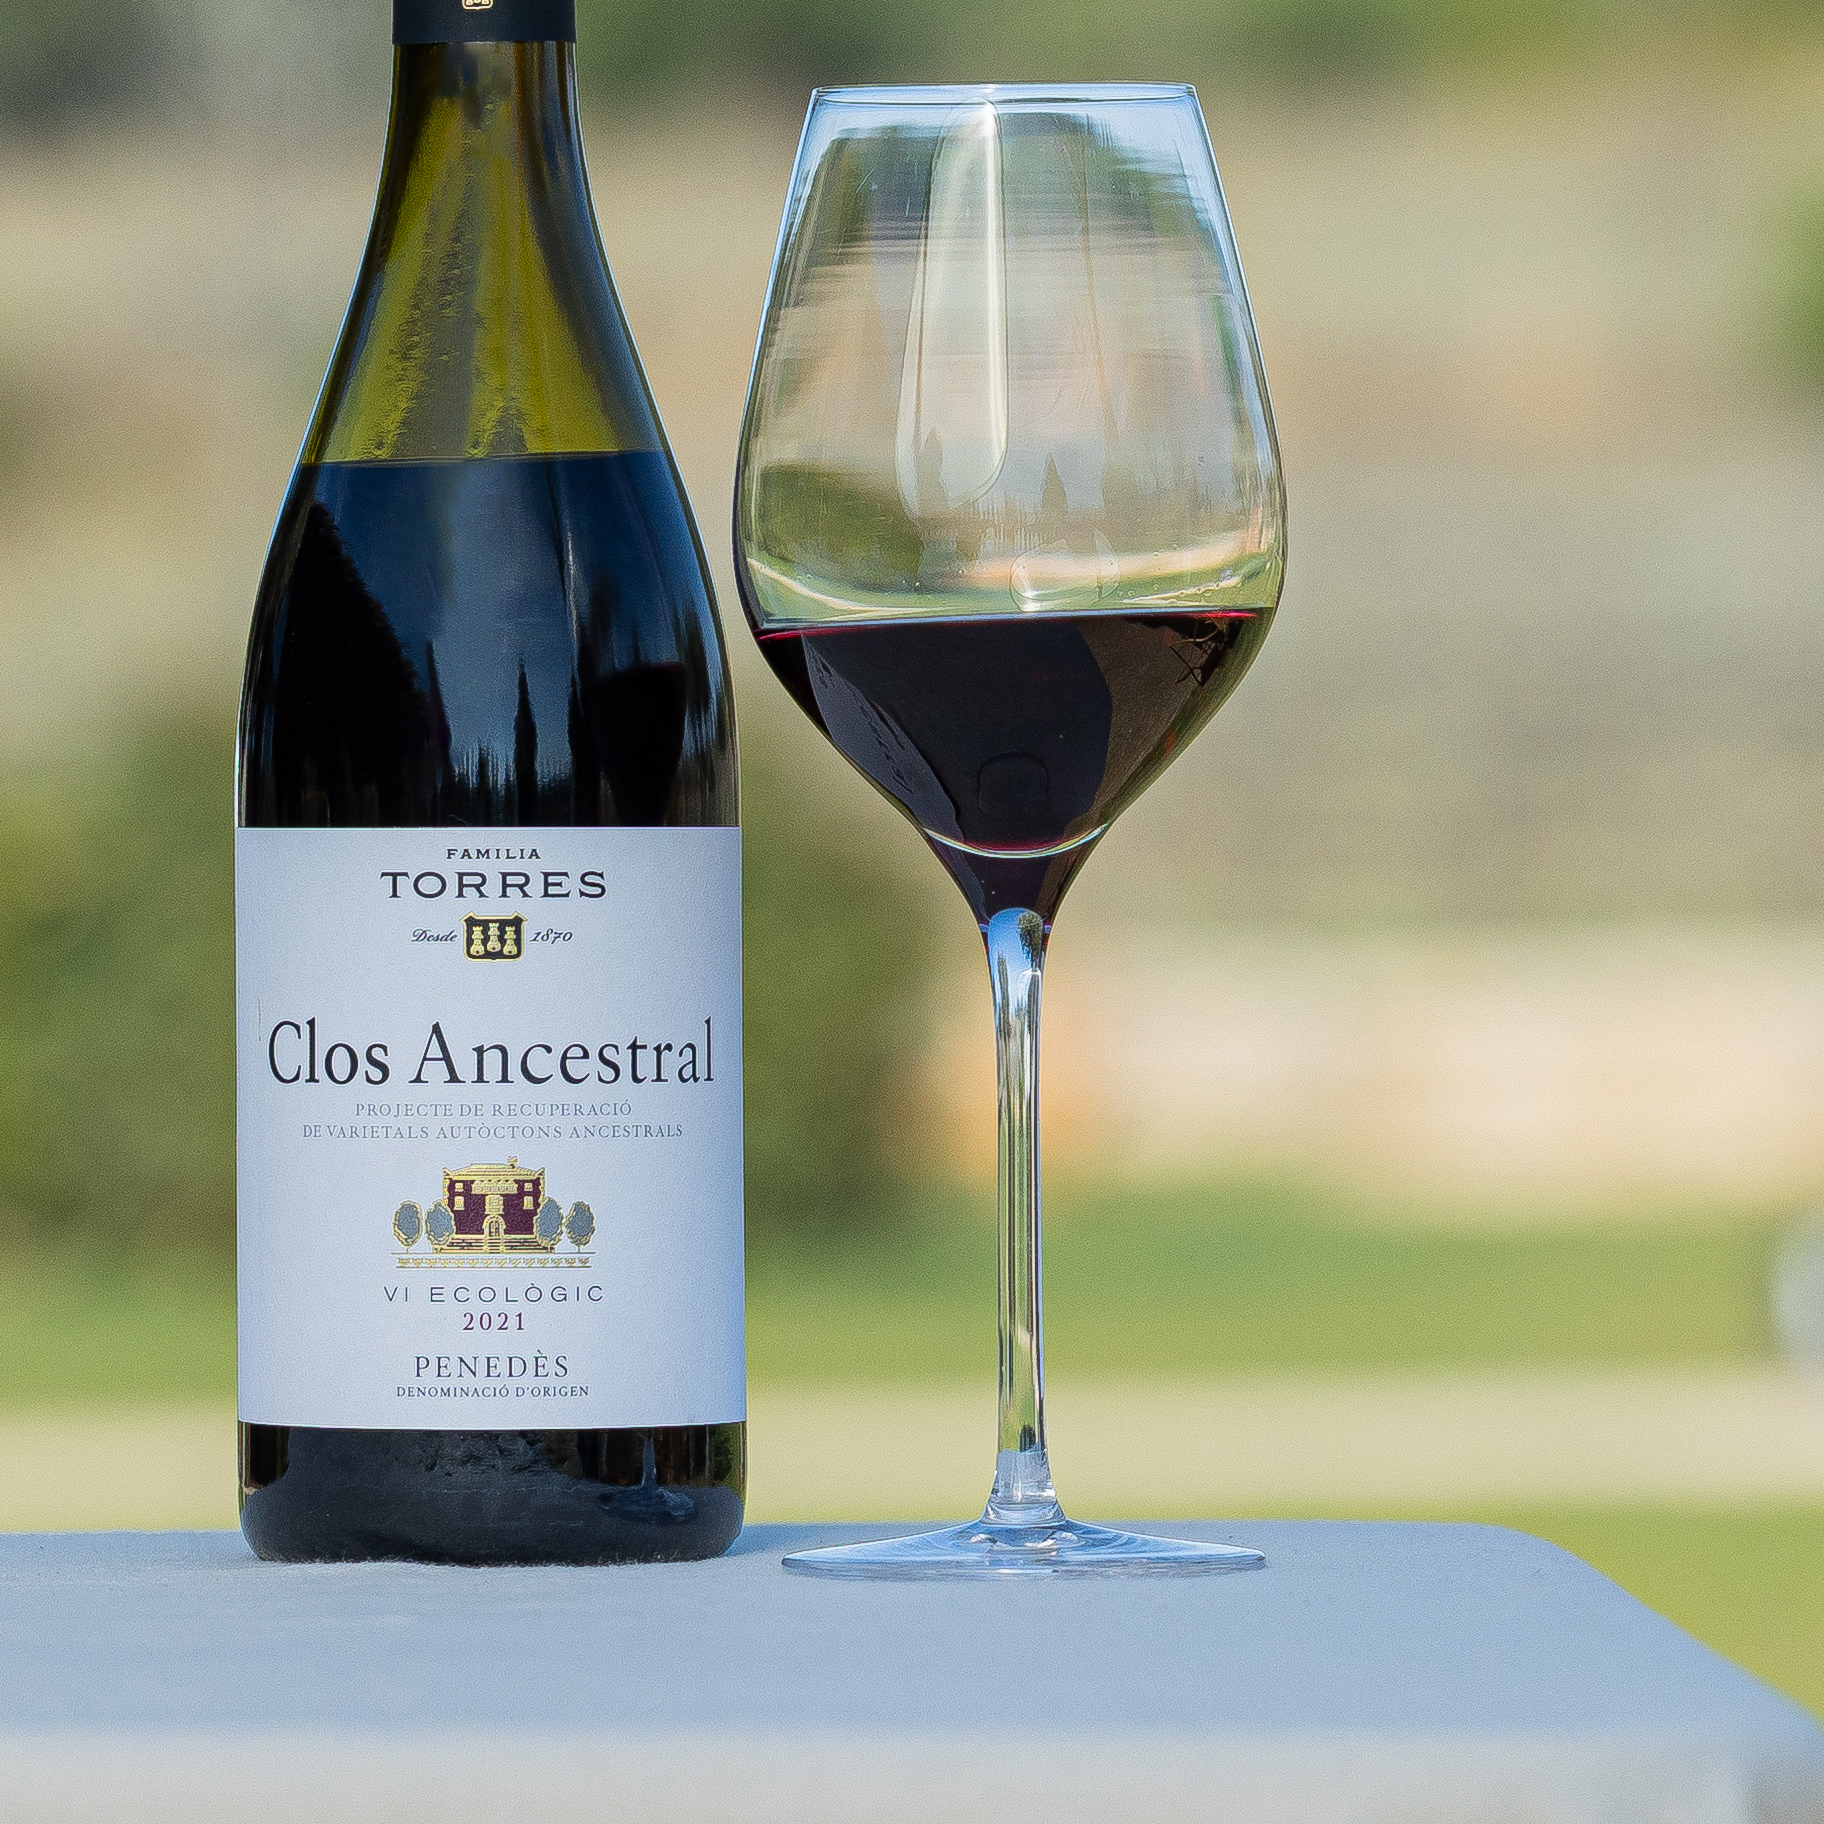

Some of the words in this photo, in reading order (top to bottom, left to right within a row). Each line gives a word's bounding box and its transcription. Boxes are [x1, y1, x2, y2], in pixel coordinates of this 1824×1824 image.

[445, 848, 542, 860] FAMILIA
[379, 870, 607, 899] TORRES
[410, 928, 458, 943] Desde
[529, 927, 574, 945] 1870
[267, 1015, 390, 1085] Clos
[408, 1015, 715, 1085] Ancestral
[354, 1102, 453, 1118] PROJECTE
[458, 1102, 484, 1117] DE
[491, 1099, 632, 1117] RECUPERACIÓ
[302, 1124, 322, 1139] DE
[326, 1124, 429, 1140] VARIETALS
[434, 1121, 563, 1140] AUTÒCTONS
[568, 1123, 684, 1139] ANCESTRALS
[383, 1285, 409, 1303] VI
[429, 1282, 604, 1303] ECOLÒGIC
[462, 1311, 525, 1331] 2021
[414, 1348, 569, 1378] PENEDÈS
[396, 1383, 510, 1398] DENOMINACIÓ
[515, 1385, 590, 1398] D'ORIGEN
